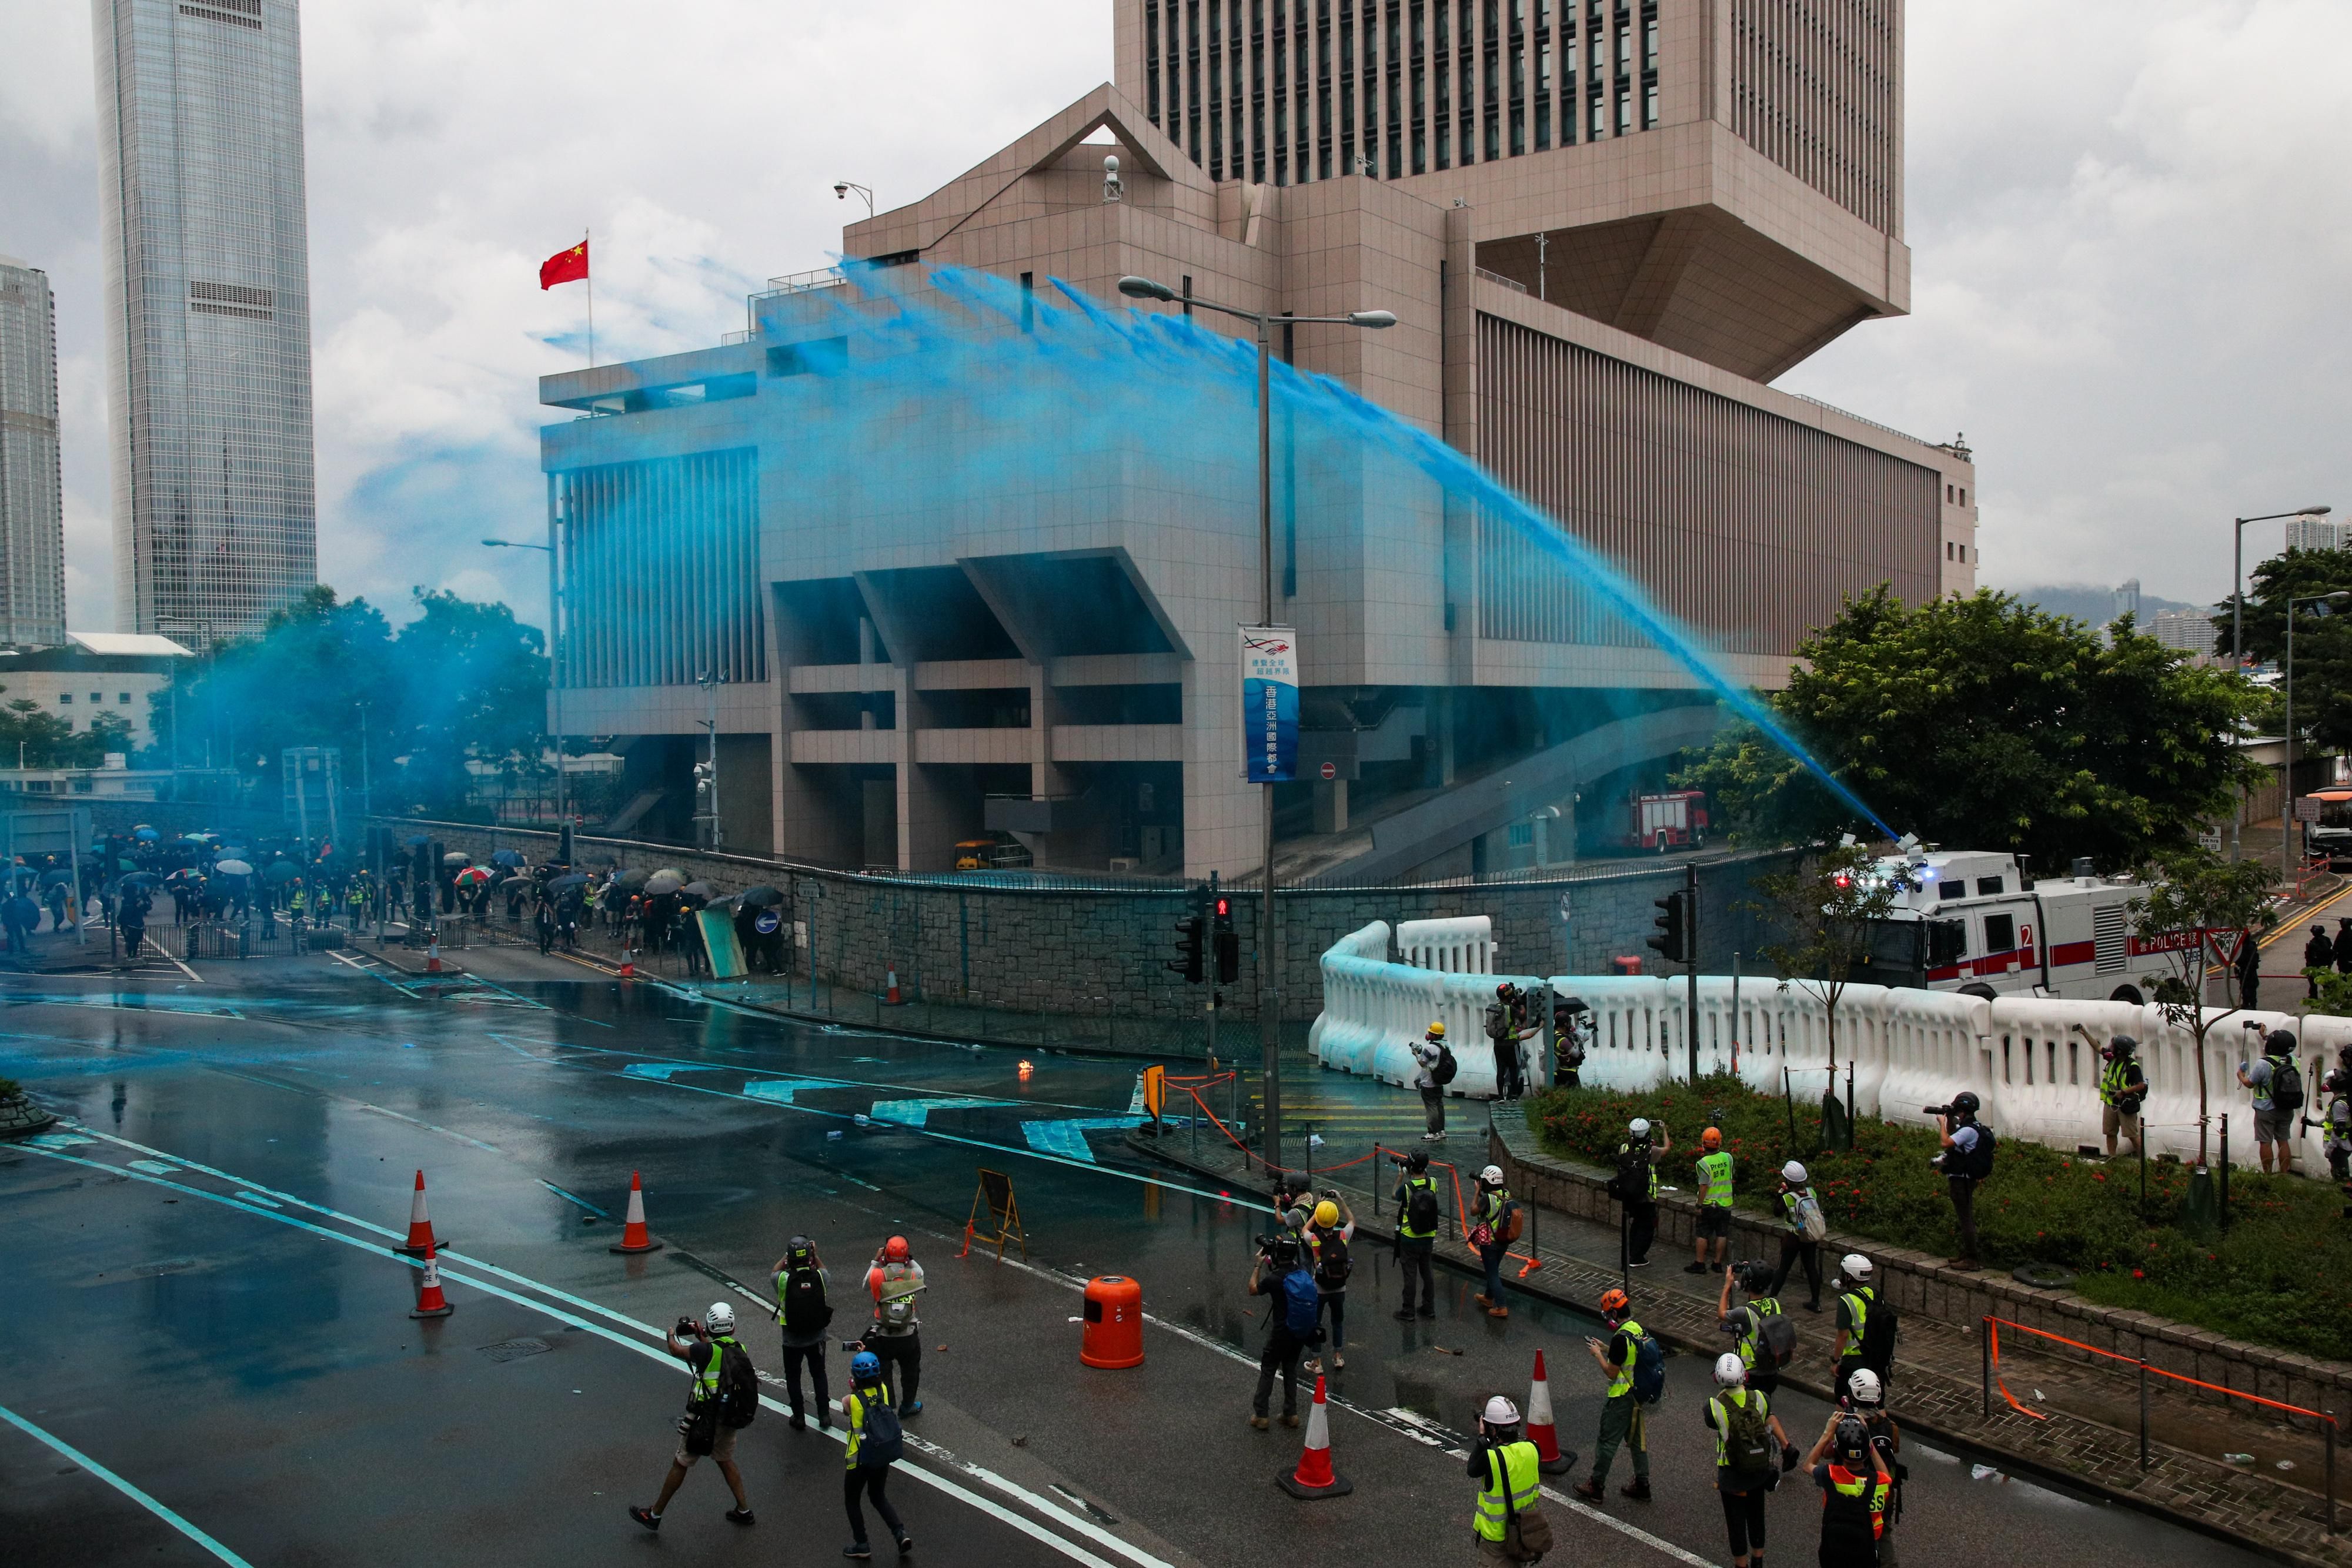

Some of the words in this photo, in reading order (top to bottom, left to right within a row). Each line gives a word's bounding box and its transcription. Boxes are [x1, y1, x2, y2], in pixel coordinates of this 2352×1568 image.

[1265, 686, 1277, 774] 香港亞洲國際都會
[2022, 925, 2033, 947] 2
[2150, 933, 2186, 951] POLICE
